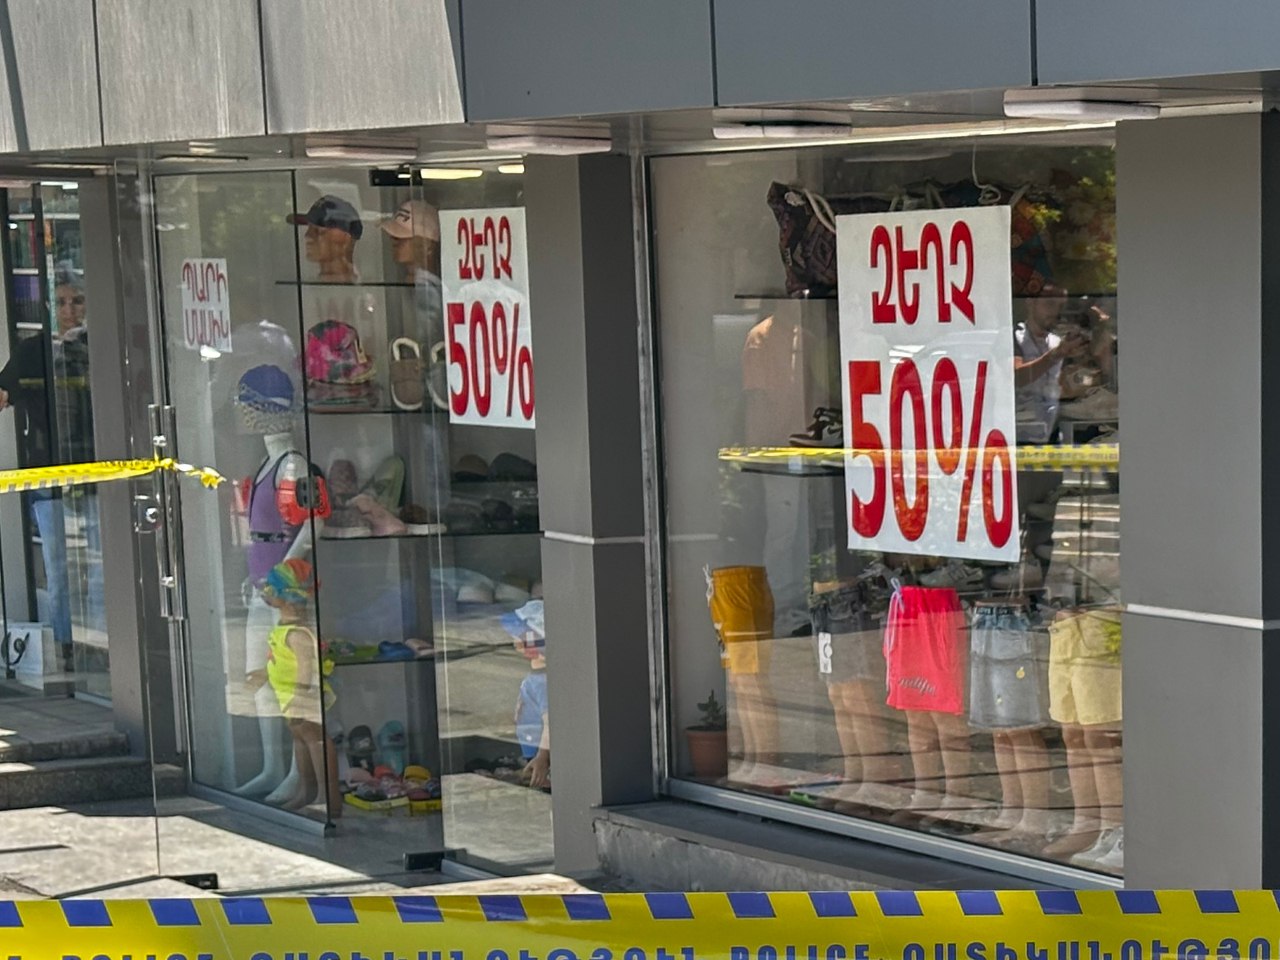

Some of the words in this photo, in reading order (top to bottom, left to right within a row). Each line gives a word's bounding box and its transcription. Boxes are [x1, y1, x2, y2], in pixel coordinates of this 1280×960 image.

[182, 262, 228, 302] ՊԱՐԻ
[458, 216, 512, 281] ԶԵՂՉ
[869, 220, 976, 326] ԶԵՂՉ
[447, 300, 536, 421] 50%
[848, 356, 1013, 549] 50%
